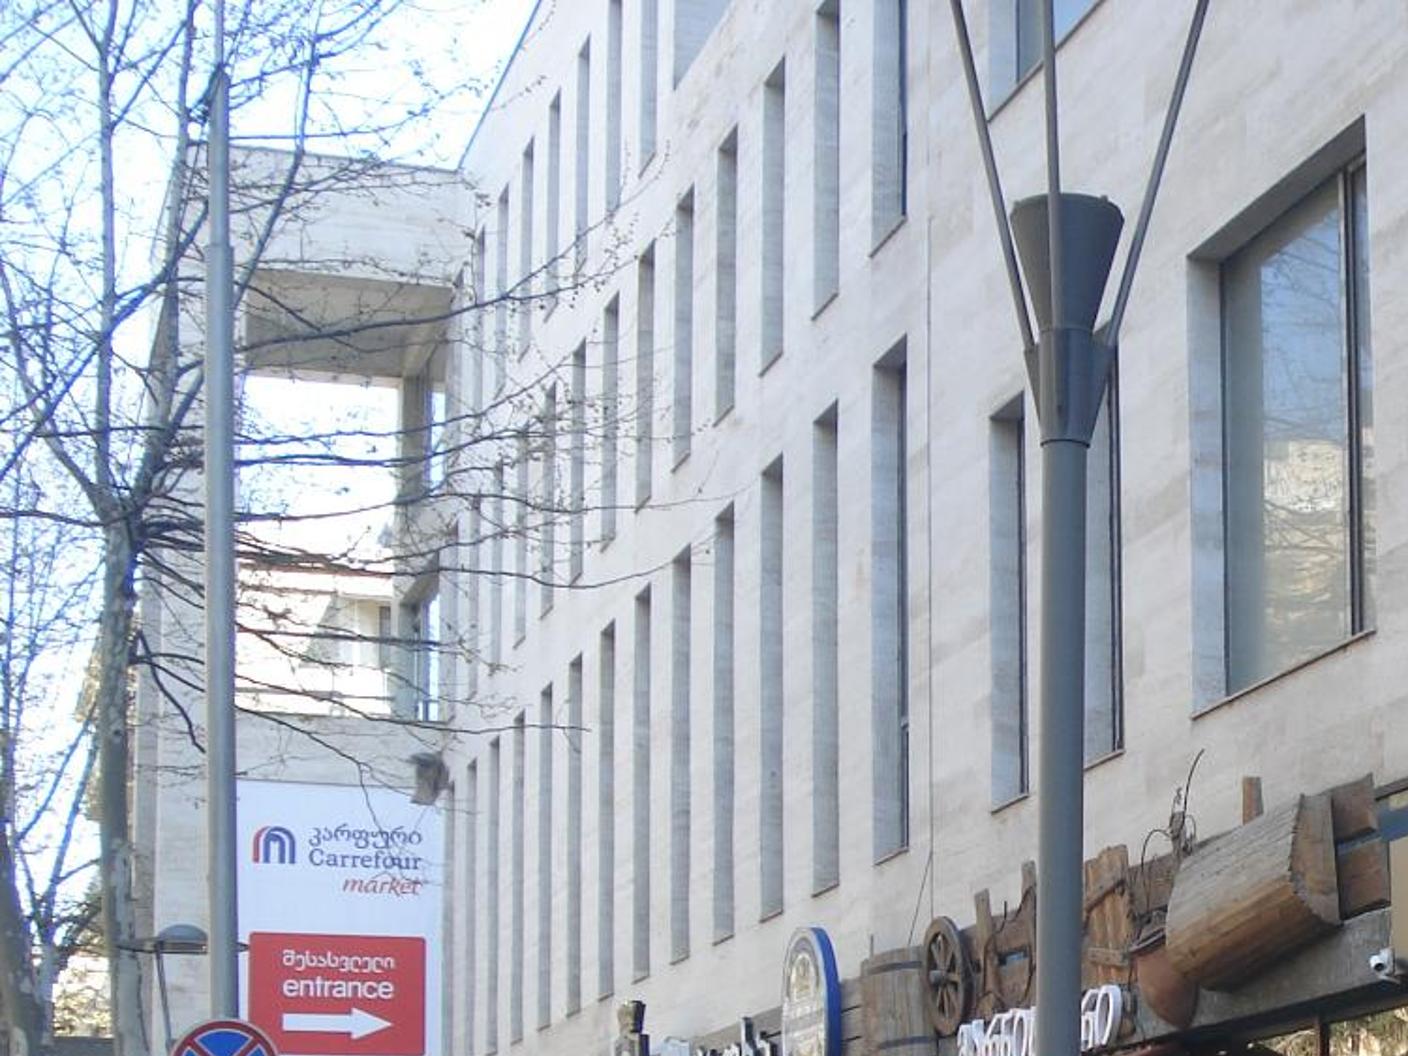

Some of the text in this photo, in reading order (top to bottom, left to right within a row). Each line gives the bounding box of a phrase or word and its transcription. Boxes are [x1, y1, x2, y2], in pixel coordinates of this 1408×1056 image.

[308, 823, 422, 849] კარფური
[308, 848, 423, 870] Carrefour
[342, 875, 423, 897] market
[282, 975, 395, 999] entrance
